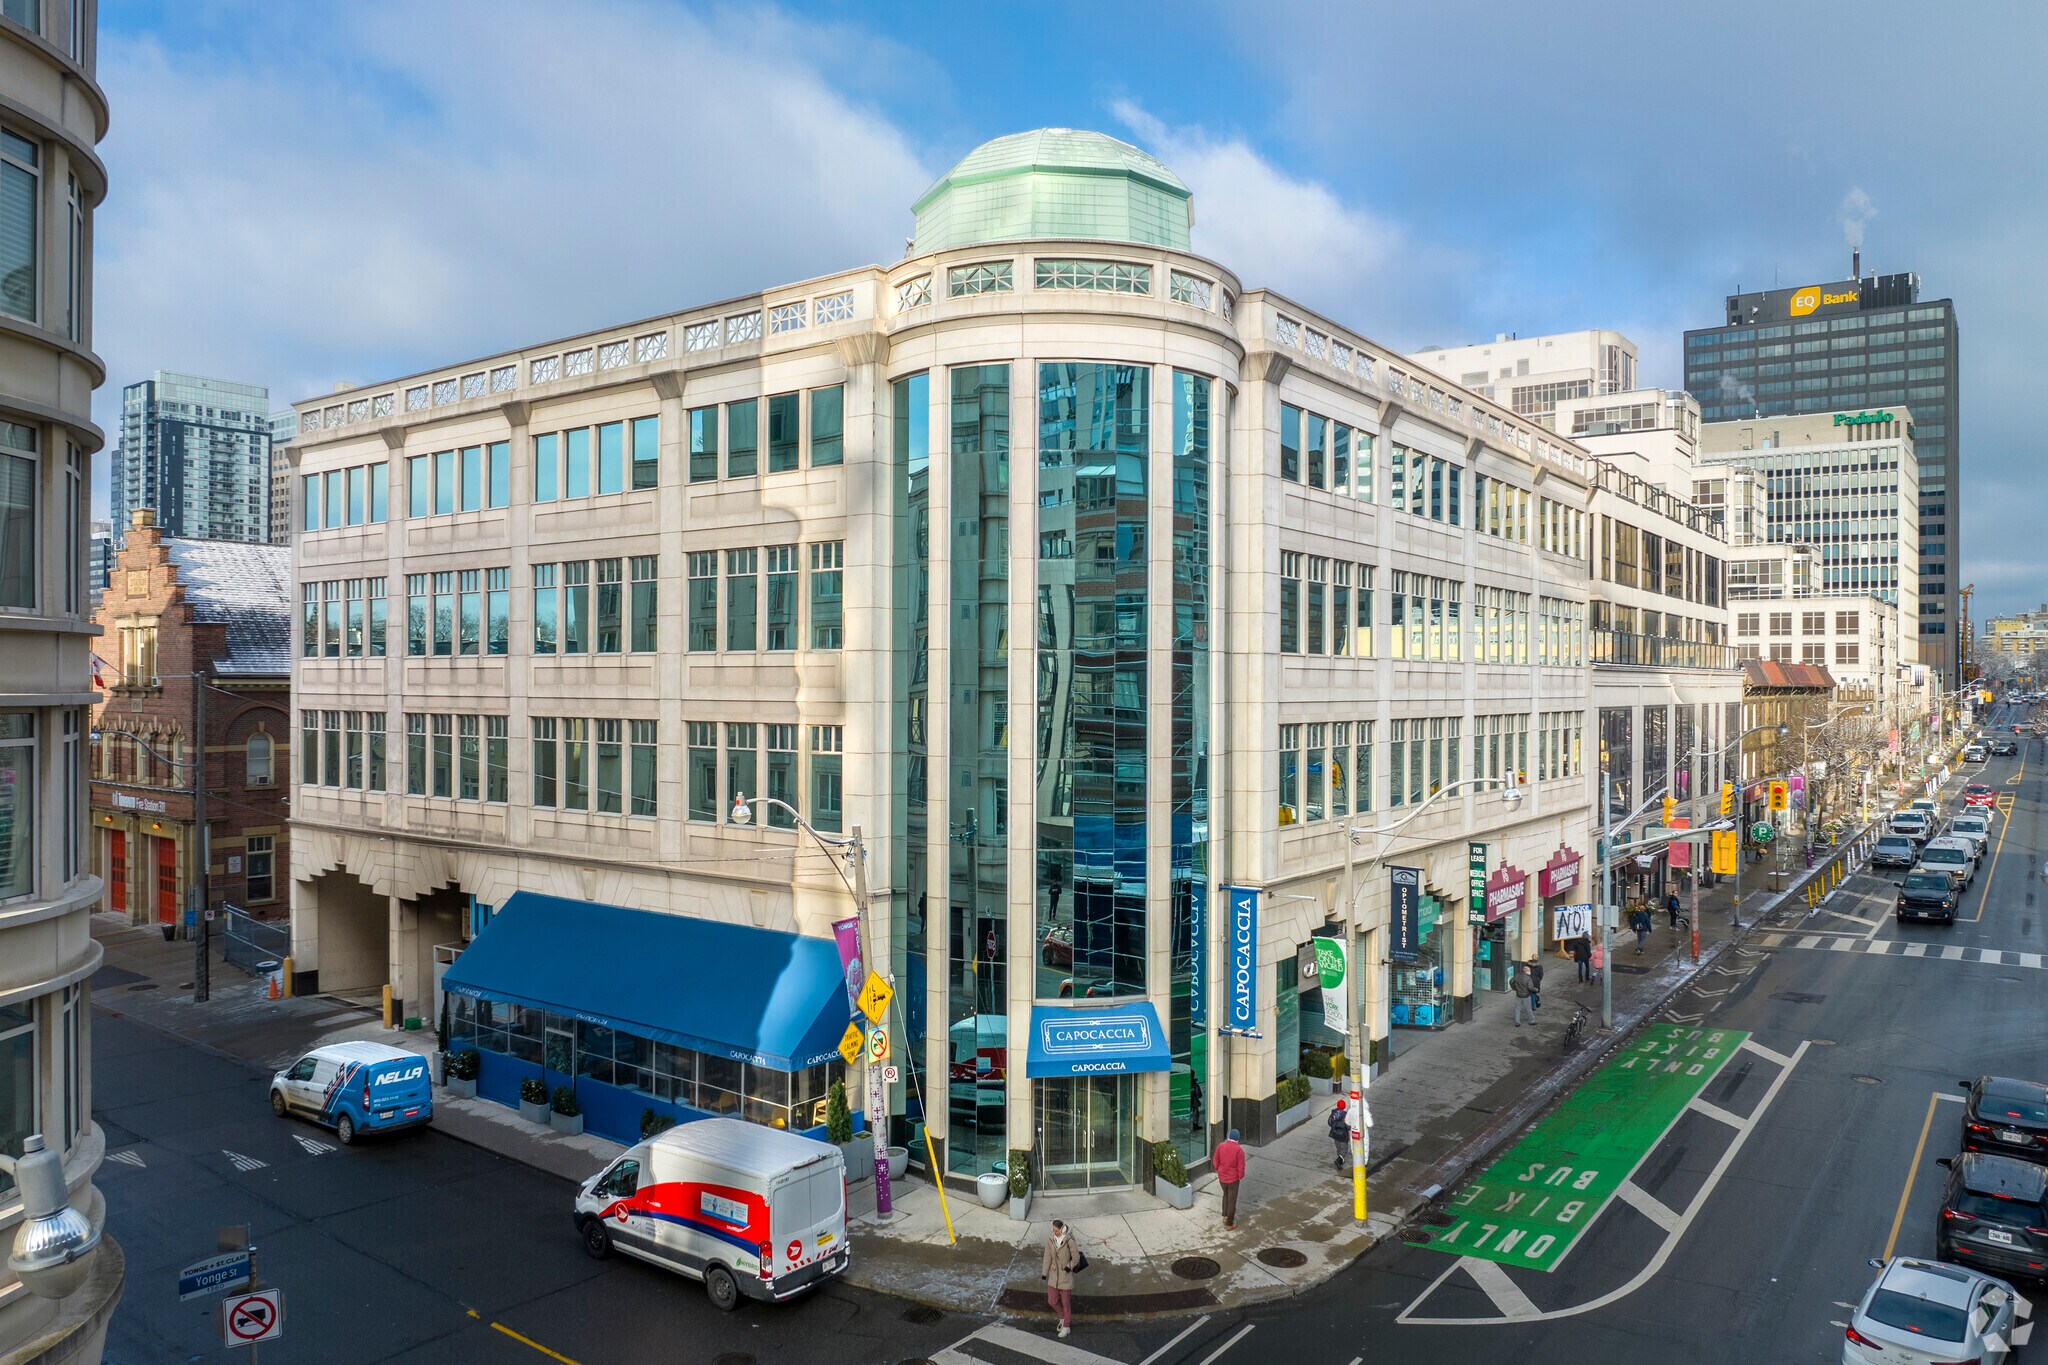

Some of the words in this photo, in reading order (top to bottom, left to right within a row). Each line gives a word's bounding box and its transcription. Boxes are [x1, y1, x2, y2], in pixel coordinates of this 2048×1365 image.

[1795, 295, 1815, 308] EQ
[1823, 290, 1858, 305] Bank
[1833, 409, 1894, 427] Padulo
[1470, 855, 1485, 863] LEASE
[1469, 869, 1486, 878] MEDICAL
[1550, 861, 1579, 884] PHARMASAVE
[1471, 879, 1485, 888] OFFICE
[1471, 889, 1484, 898] SPACE
[1489, 881, 1524, 908] PHARMASAVE
[1567, 904, 1590, 912] Notice
[837, 921, 853, 931] YONGE
[1316, 948, 1334, 958] TAKE
[1236, 898, 1251, 1021] CAPOCACCIA
[1318, 956, 1331, 965] ON
[1330, 956, 1342, 966] THE
[1319, 961, 1343, 973] WORLD
[1324, 994, 1334, 1003] THE
[1325, 1002, 1339, 1012] YORK
[844, 1030, 859, 1041] TRAFFIC
[1056, 1028, 1135, 1041] CAPOCACCIA
[1666, 1028, 1725, 1044] BUS
[844, 1039, 859, 1051] CALMING
[1637, 1041, 1721, 1060] BIKE
[806, 1050, 842, 1065] CAPOCACC
[847, 1049, 857, 1059] ZONE
[1071, 1062, 1126, 1072] CAPOCACCIA
[1620, 1057, 1705, 1076] ONLY
[375, 1066, 423, 1086] NELLA
[1517, 1163, 1599, 1191] BUS
[1454, 1185, 1586, 1223] BIKE
[1439, 1221, 1556, 1259] ONLY
[184, 1264, 208, 1276] YONGE
[226, 1254, 246, 1265] CLAIR
[741, 1260, 759, 1271] HYBRID
[196, 1271, 228, 1288] Yonge
[229, 1268, 237, 1277] St
